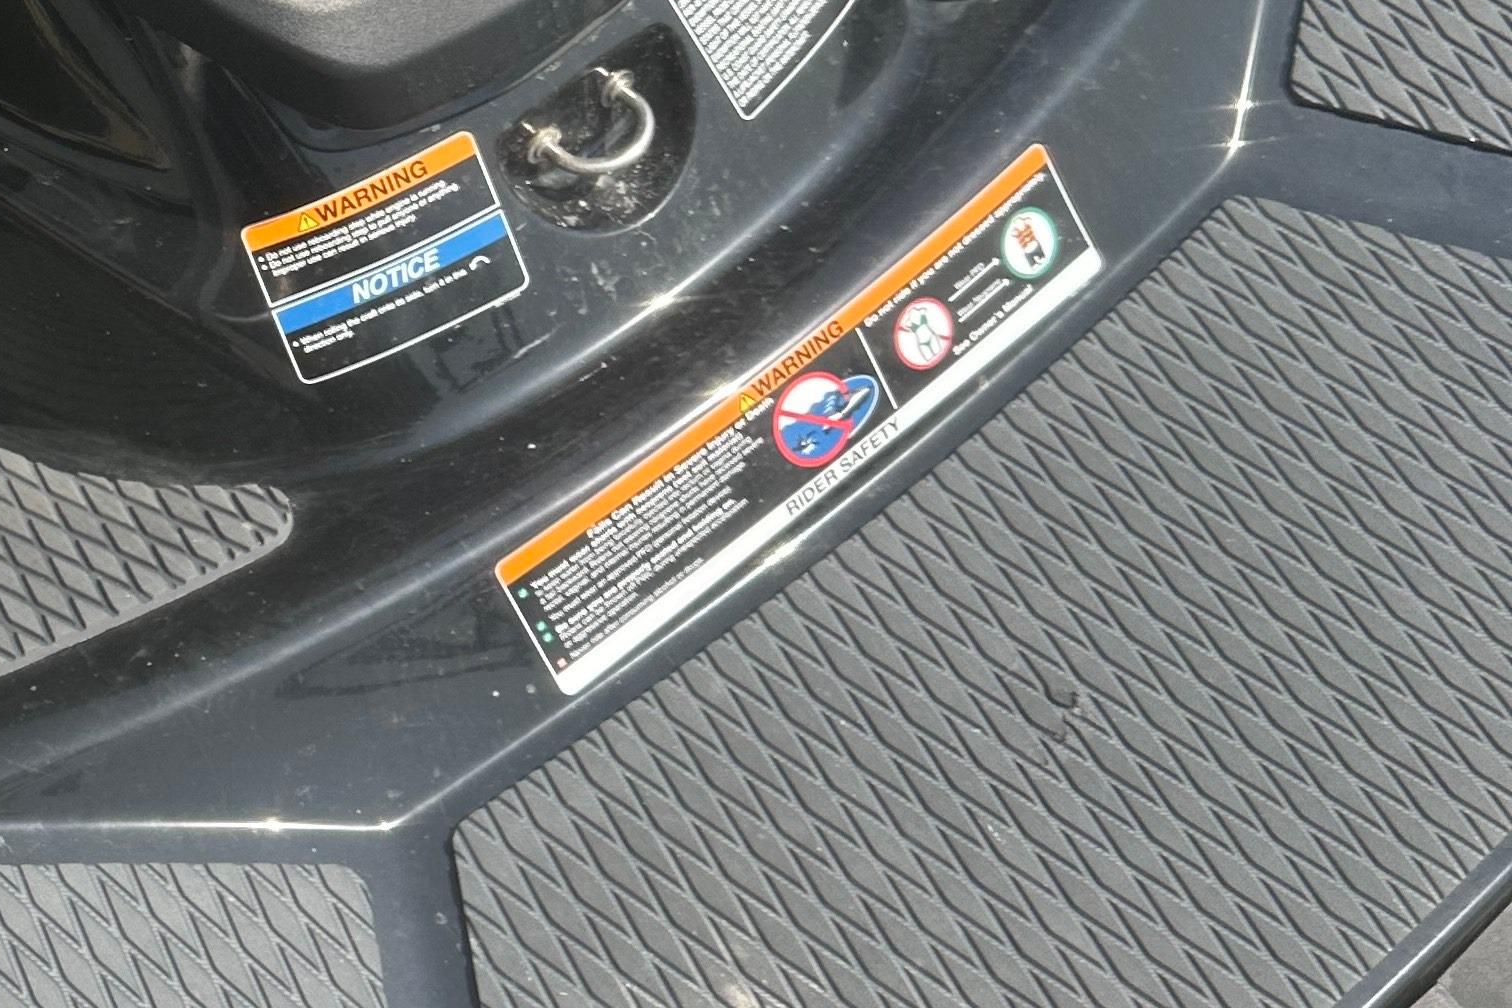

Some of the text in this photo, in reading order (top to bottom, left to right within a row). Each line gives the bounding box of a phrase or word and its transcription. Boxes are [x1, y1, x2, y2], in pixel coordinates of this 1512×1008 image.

[314, 160, 429, 222] WARNING
[351, 247, 441, 305] NOTICE
[752, 320, 846, 398] WARNING
[783, 417, 904, 514] RIDER SAFETY
